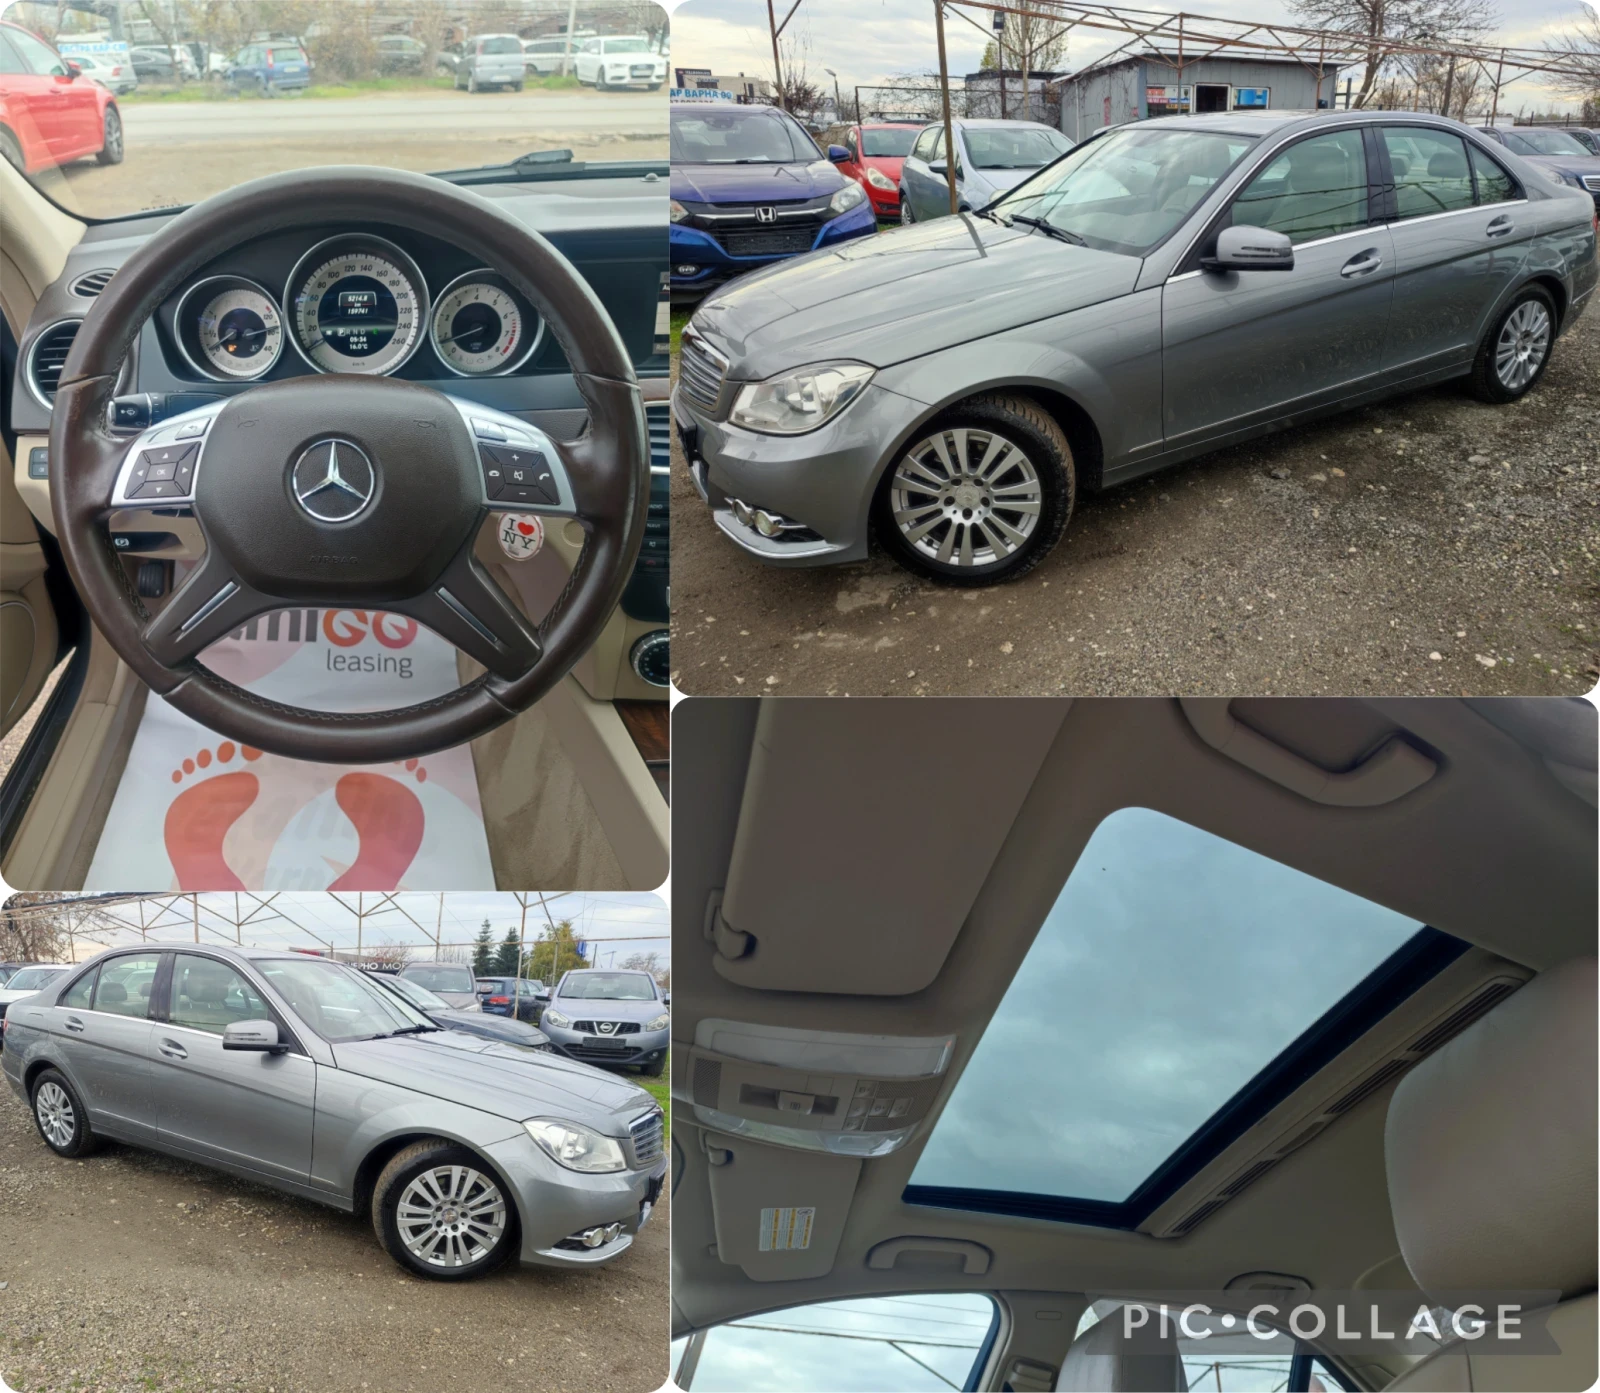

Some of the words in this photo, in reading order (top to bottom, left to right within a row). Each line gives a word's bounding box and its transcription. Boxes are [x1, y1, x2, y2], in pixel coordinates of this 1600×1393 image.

[684, 89, 719, 99] ВАРНА
[360, 264, 373, 272] 140
[317, 281, 327, 289] 80
[308, 324, 317, 332] 20
[391, 337, 406, 345] 260
[502, 529, 536, 549] NY
[326, 648, 414, 679] leasing
